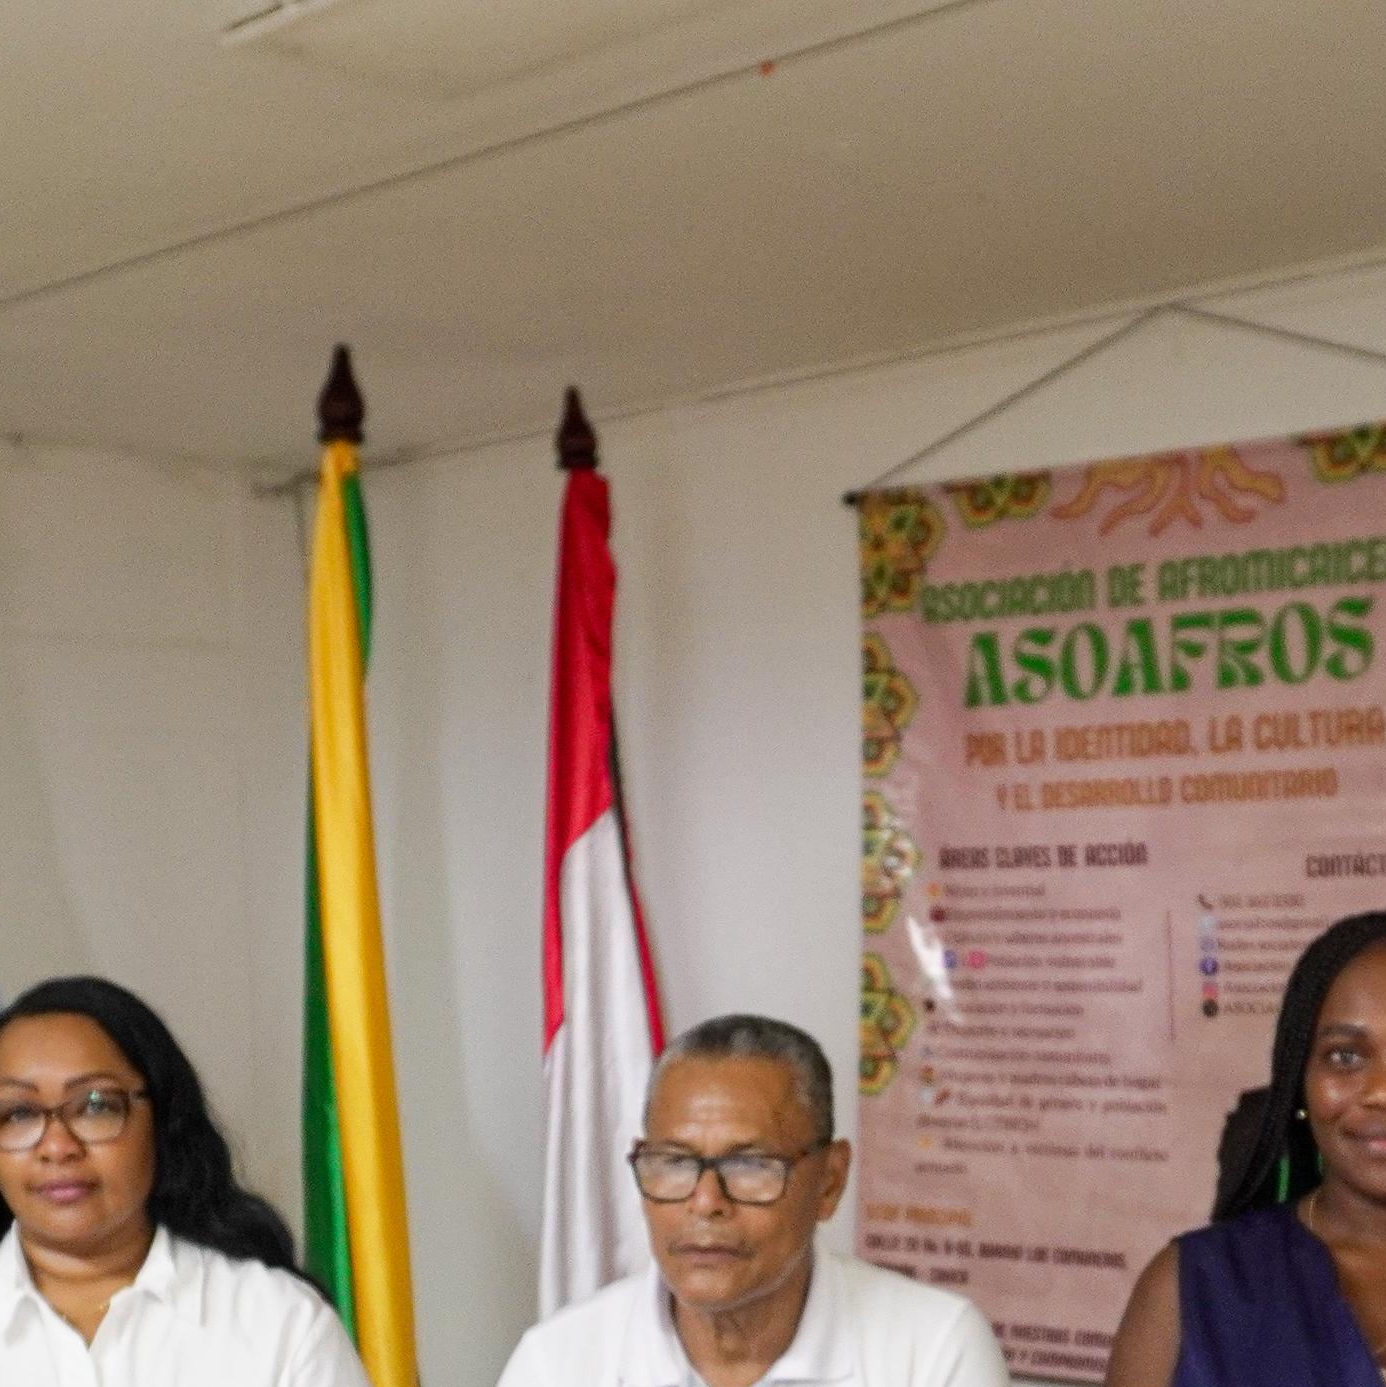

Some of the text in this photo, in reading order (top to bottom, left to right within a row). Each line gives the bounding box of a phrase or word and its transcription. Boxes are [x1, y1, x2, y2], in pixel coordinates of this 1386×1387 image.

[1107, 563, 1146, 607] DE
[965, 597, 1375, 708] ASOAFROS
[1015, 729, 1045, 765] LA
[1208, 715, 1243, 753] LA
[1253, 706, 1386, 751] CULTURA
